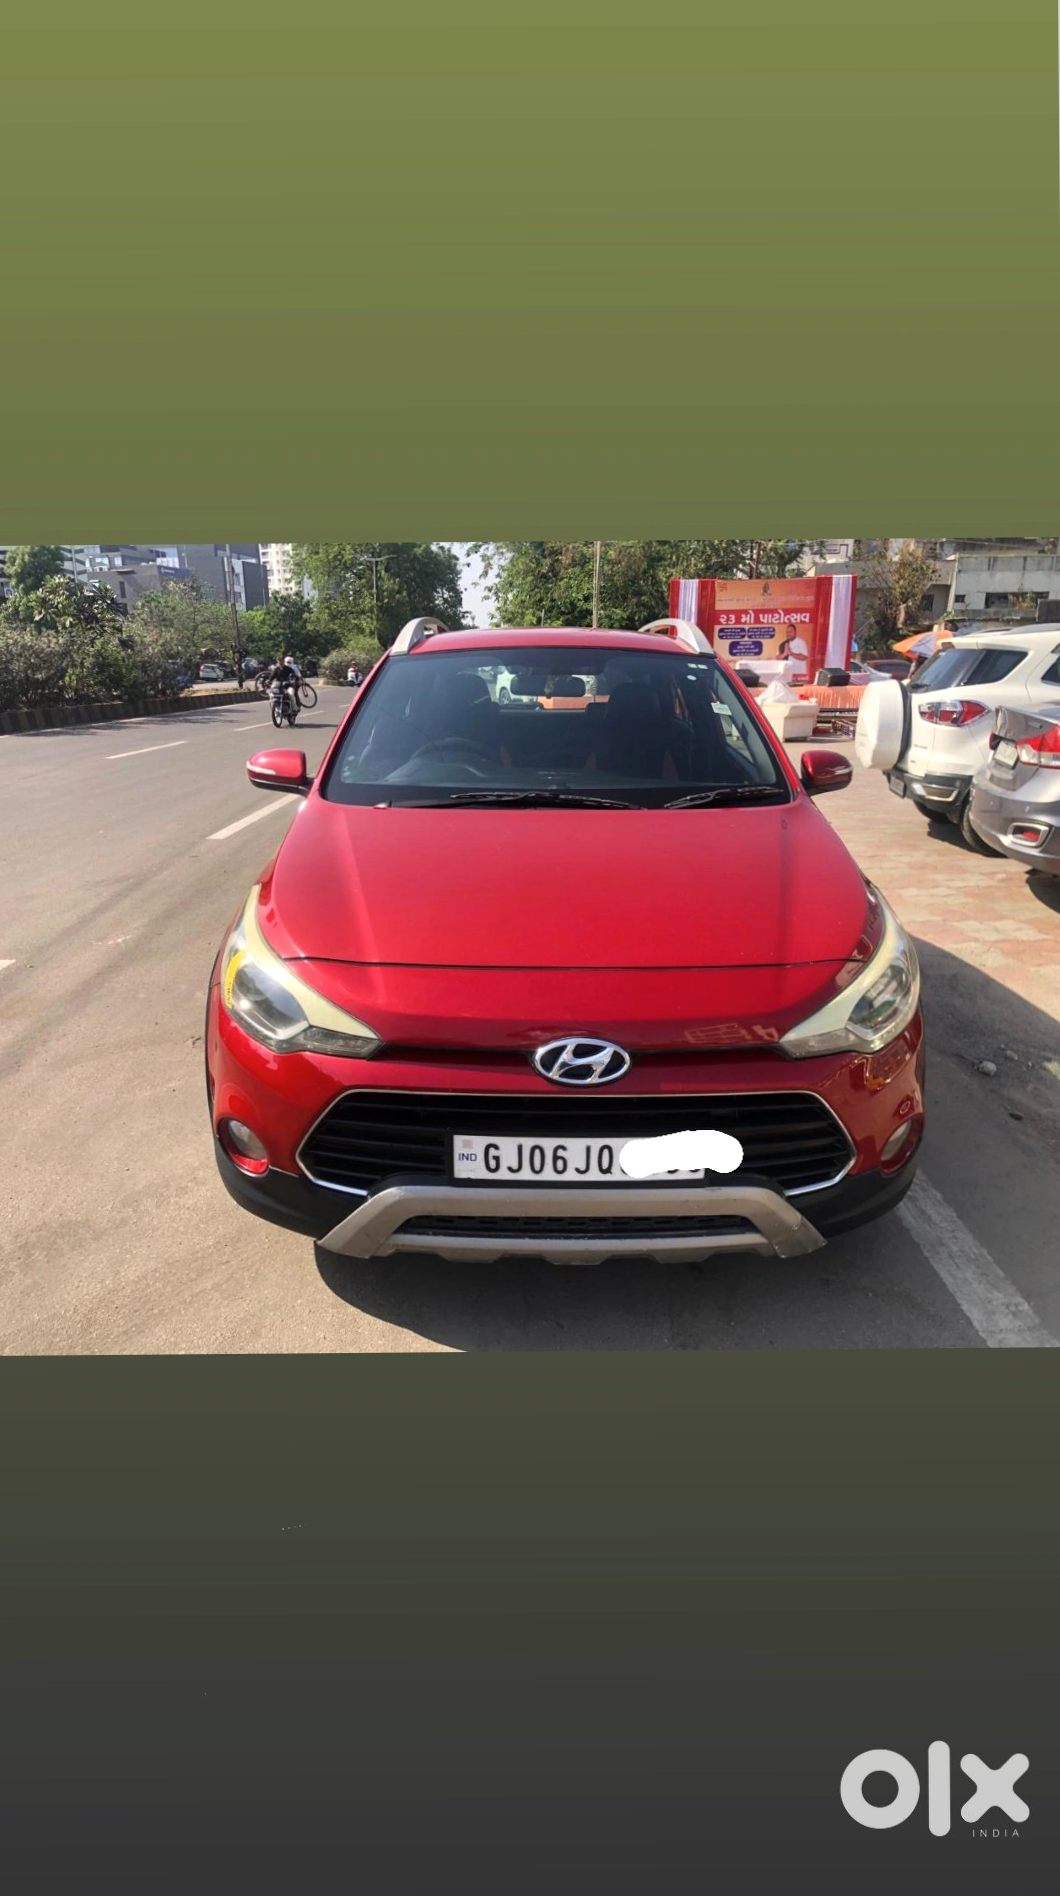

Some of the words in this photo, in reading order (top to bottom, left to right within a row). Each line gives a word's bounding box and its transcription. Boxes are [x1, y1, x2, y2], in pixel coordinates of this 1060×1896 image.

[719, 614, 736, 625] ૨૩
[741, 610, 755, 624] મો
[759, 609, 810, 624] પાટોત્સવ
[458, 1153, 478, 1162] IND
[484, 1143, 701, 1175] GJ06JQ
